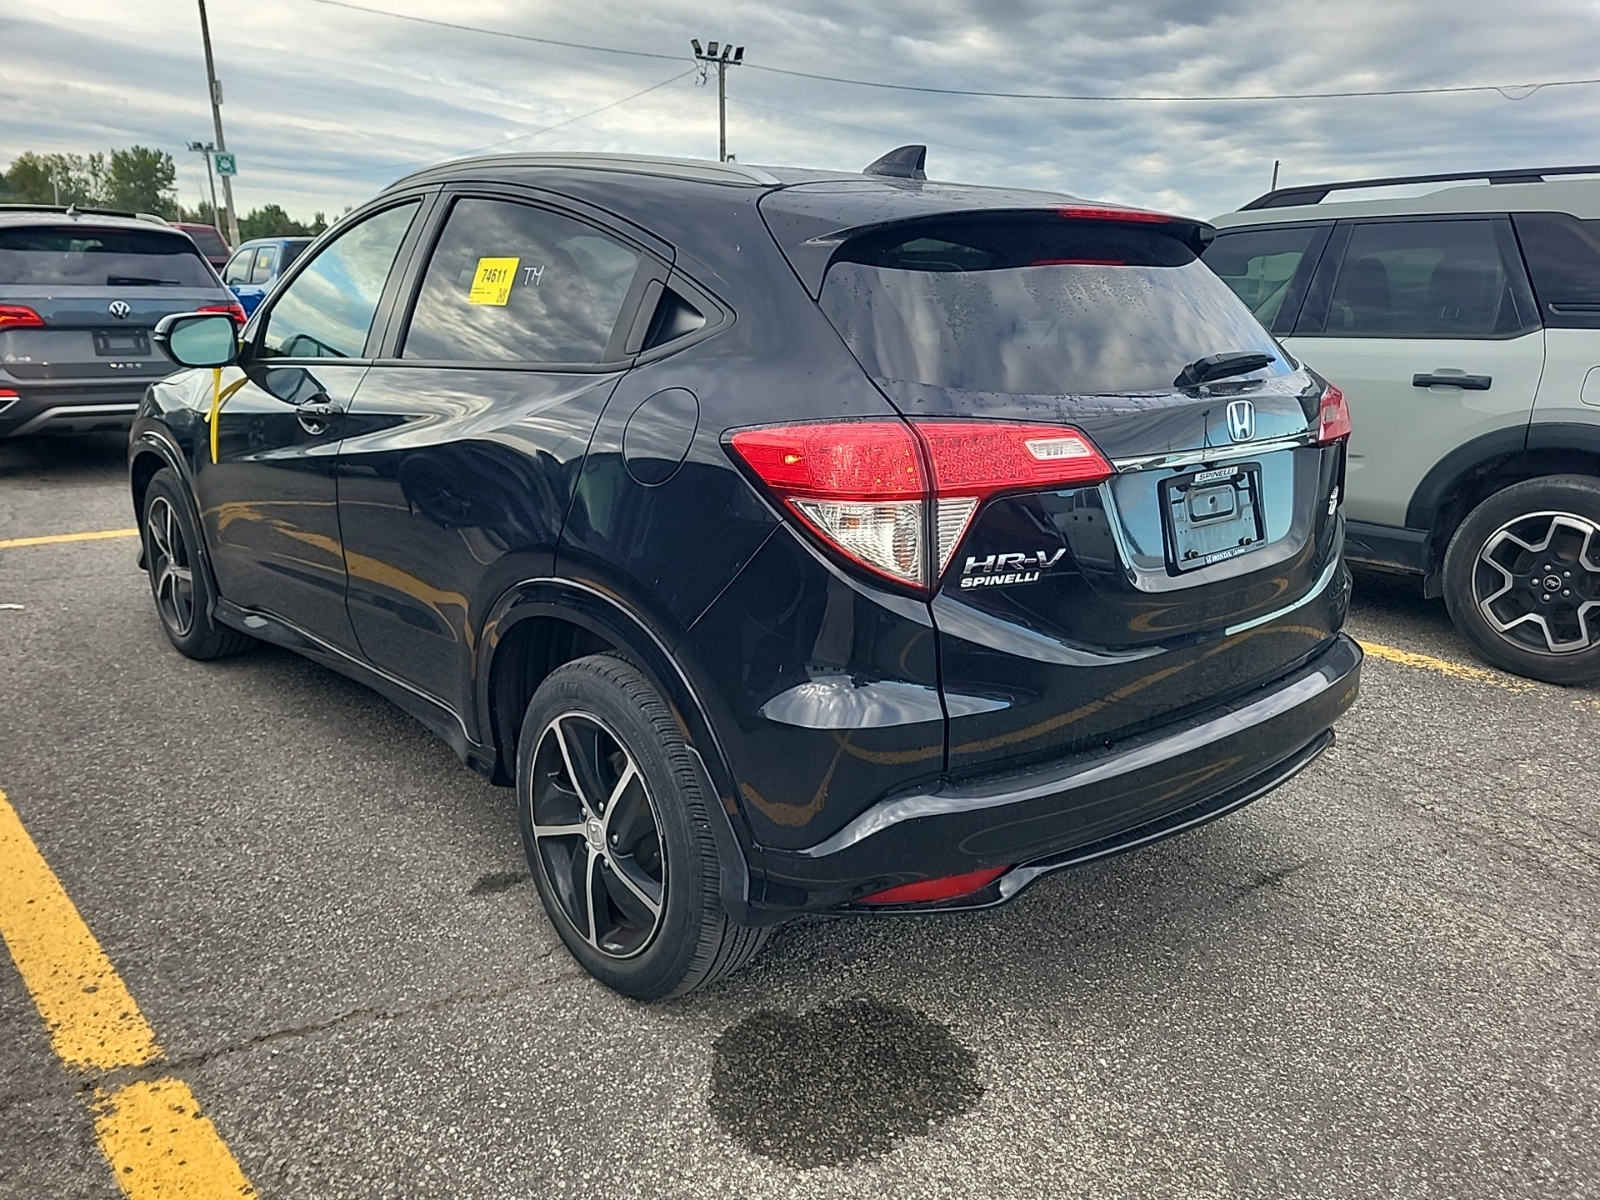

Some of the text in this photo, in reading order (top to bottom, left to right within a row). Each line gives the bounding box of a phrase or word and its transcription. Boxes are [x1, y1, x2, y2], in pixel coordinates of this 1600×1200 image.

[481, 268, 508, 283] 74611
[1199, 467, 1236, 481] SPINELLI
[963, 548, 1067, 575] HR-V
[960, 571, 1041, 588] SPINELLI
